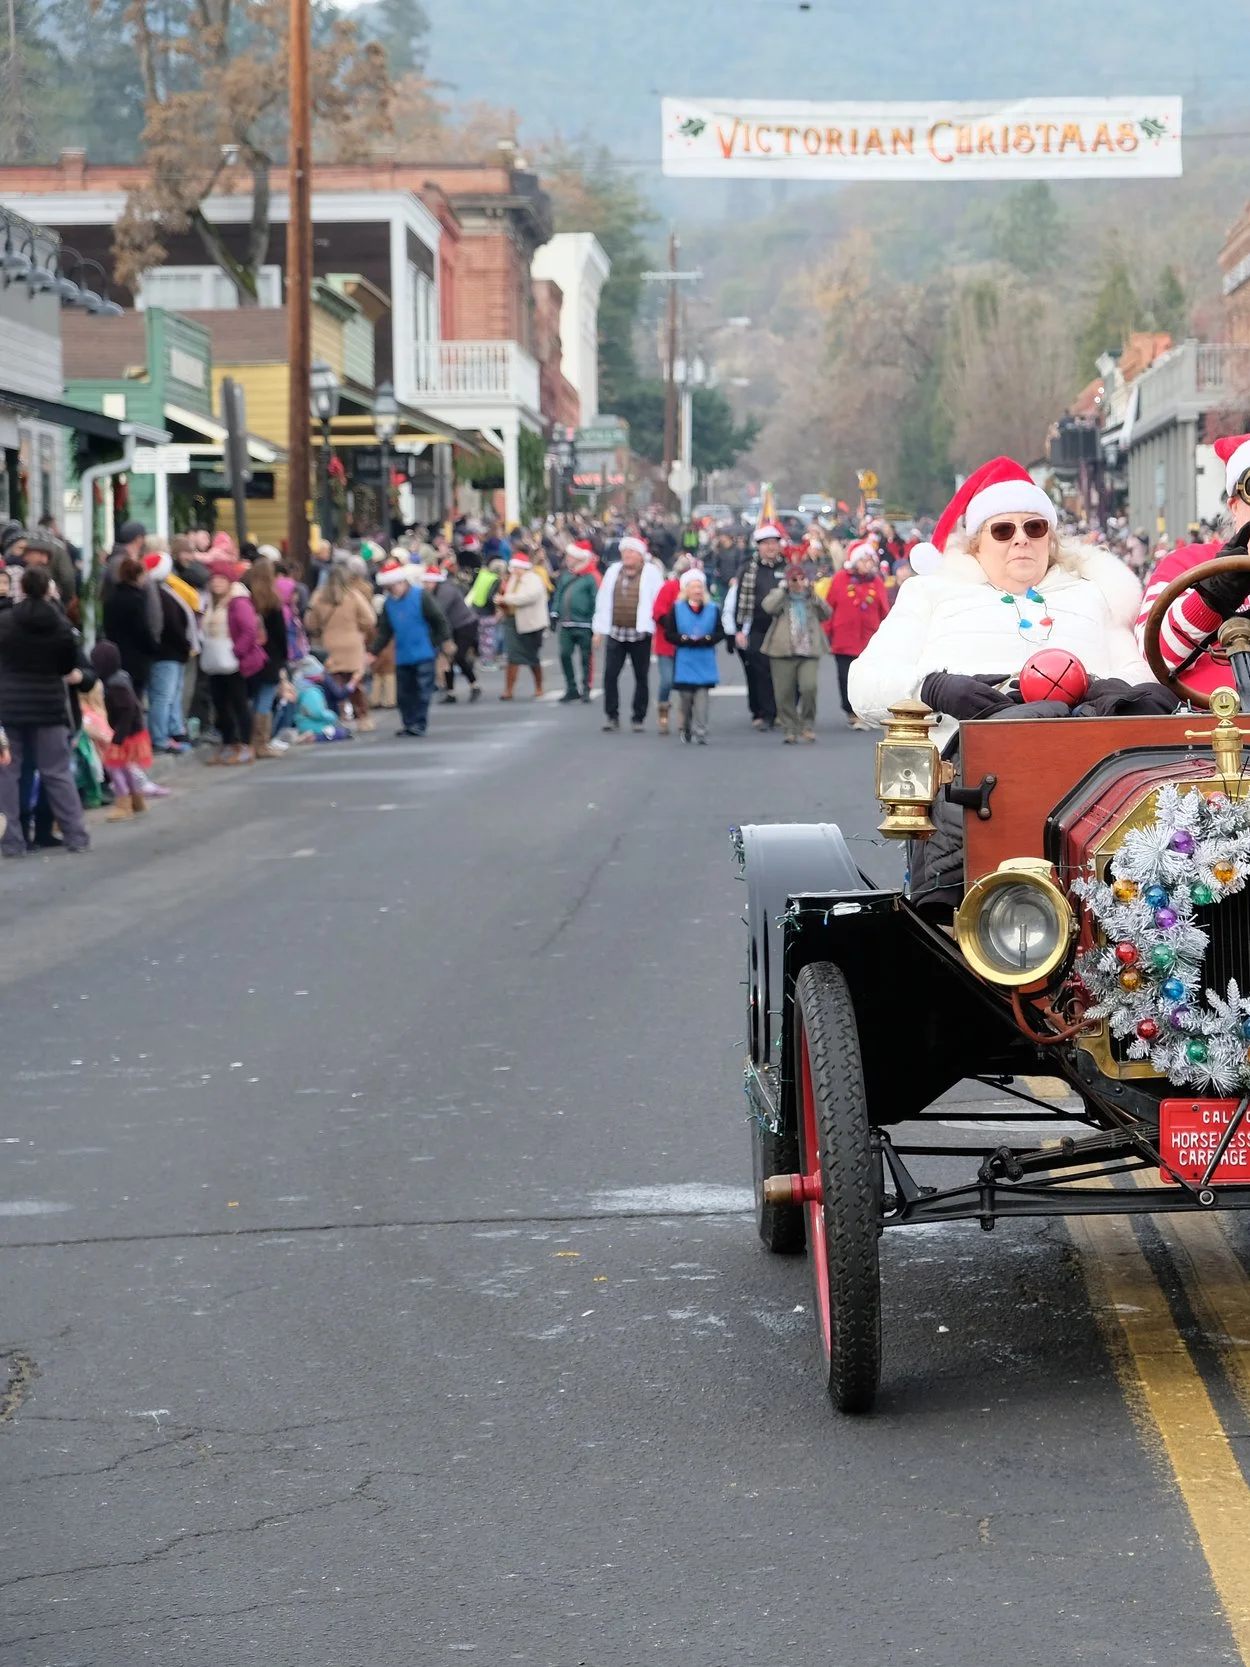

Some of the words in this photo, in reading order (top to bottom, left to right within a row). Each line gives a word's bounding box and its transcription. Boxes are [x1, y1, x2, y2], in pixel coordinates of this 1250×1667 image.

[716, 117, 916, 159] VICTORIAN
[927, 119, 1139, 163] CHRISTMAS
[1179, 1150, 1248, 1166] CARRAGE
